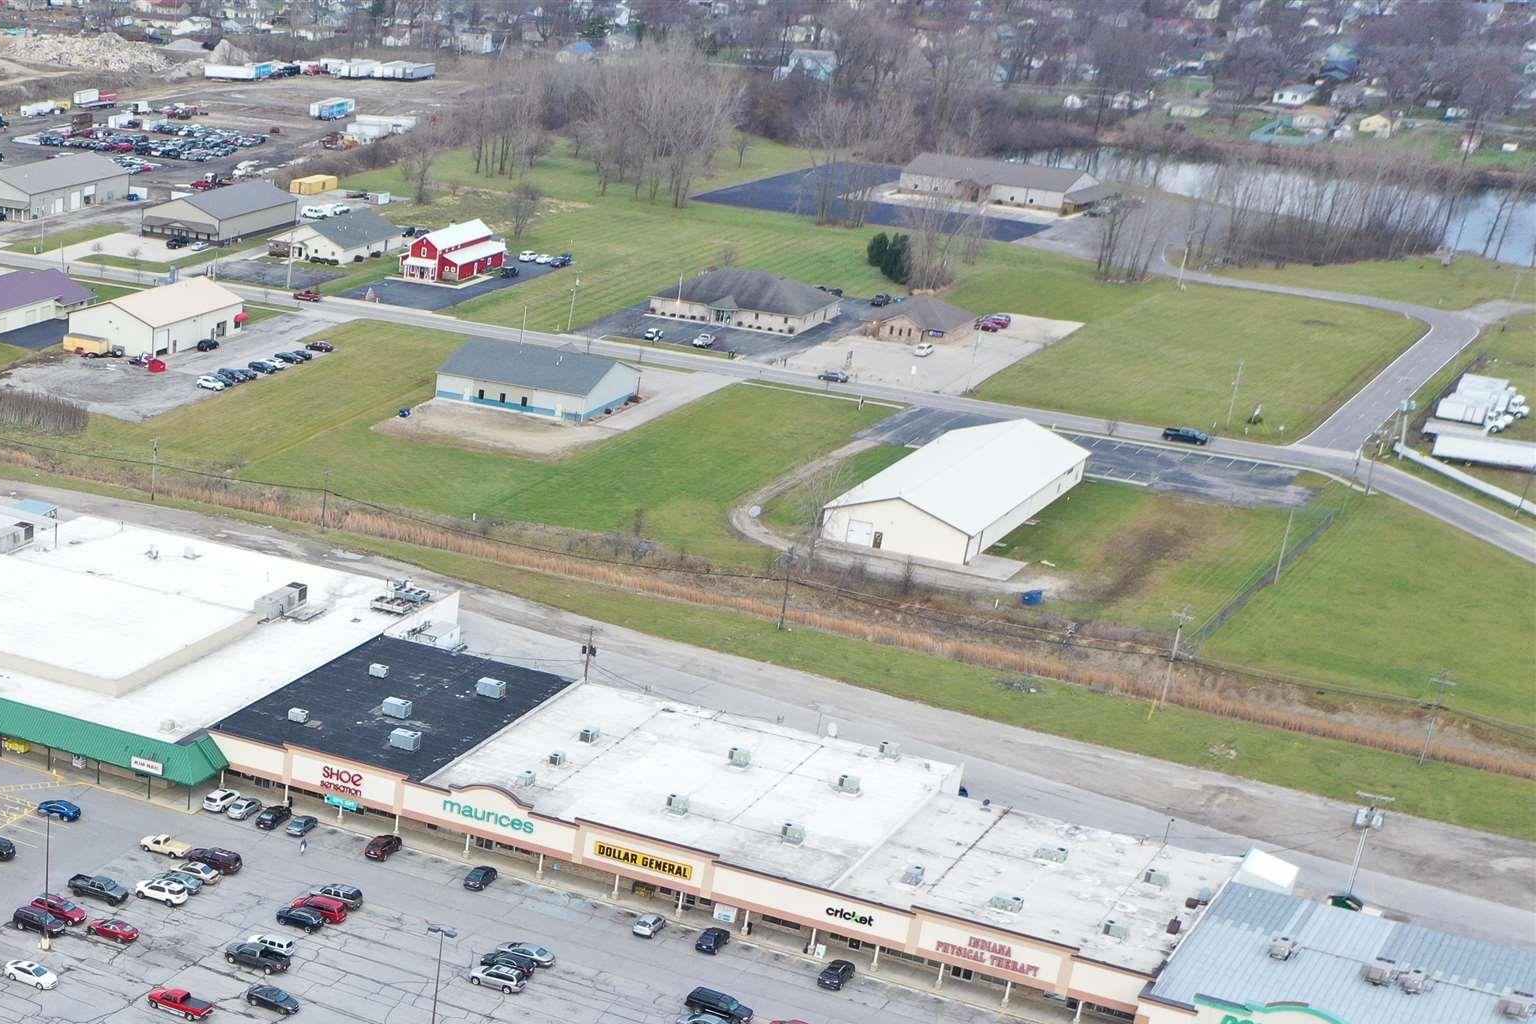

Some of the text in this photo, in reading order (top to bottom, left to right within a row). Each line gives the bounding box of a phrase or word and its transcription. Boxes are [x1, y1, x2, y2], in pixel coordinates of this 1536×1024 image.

[322, 765, 363, 787] SHOE
[443, 799, 534, 834] maurices
[598, 844, 688, 878] DOLLAR GENERAL
[825, 907, 874, 927] cricket
[935, 940, 1040, 977] PHYSICAL THERAPY
[968, 936, 1012, 957] INDIANA
